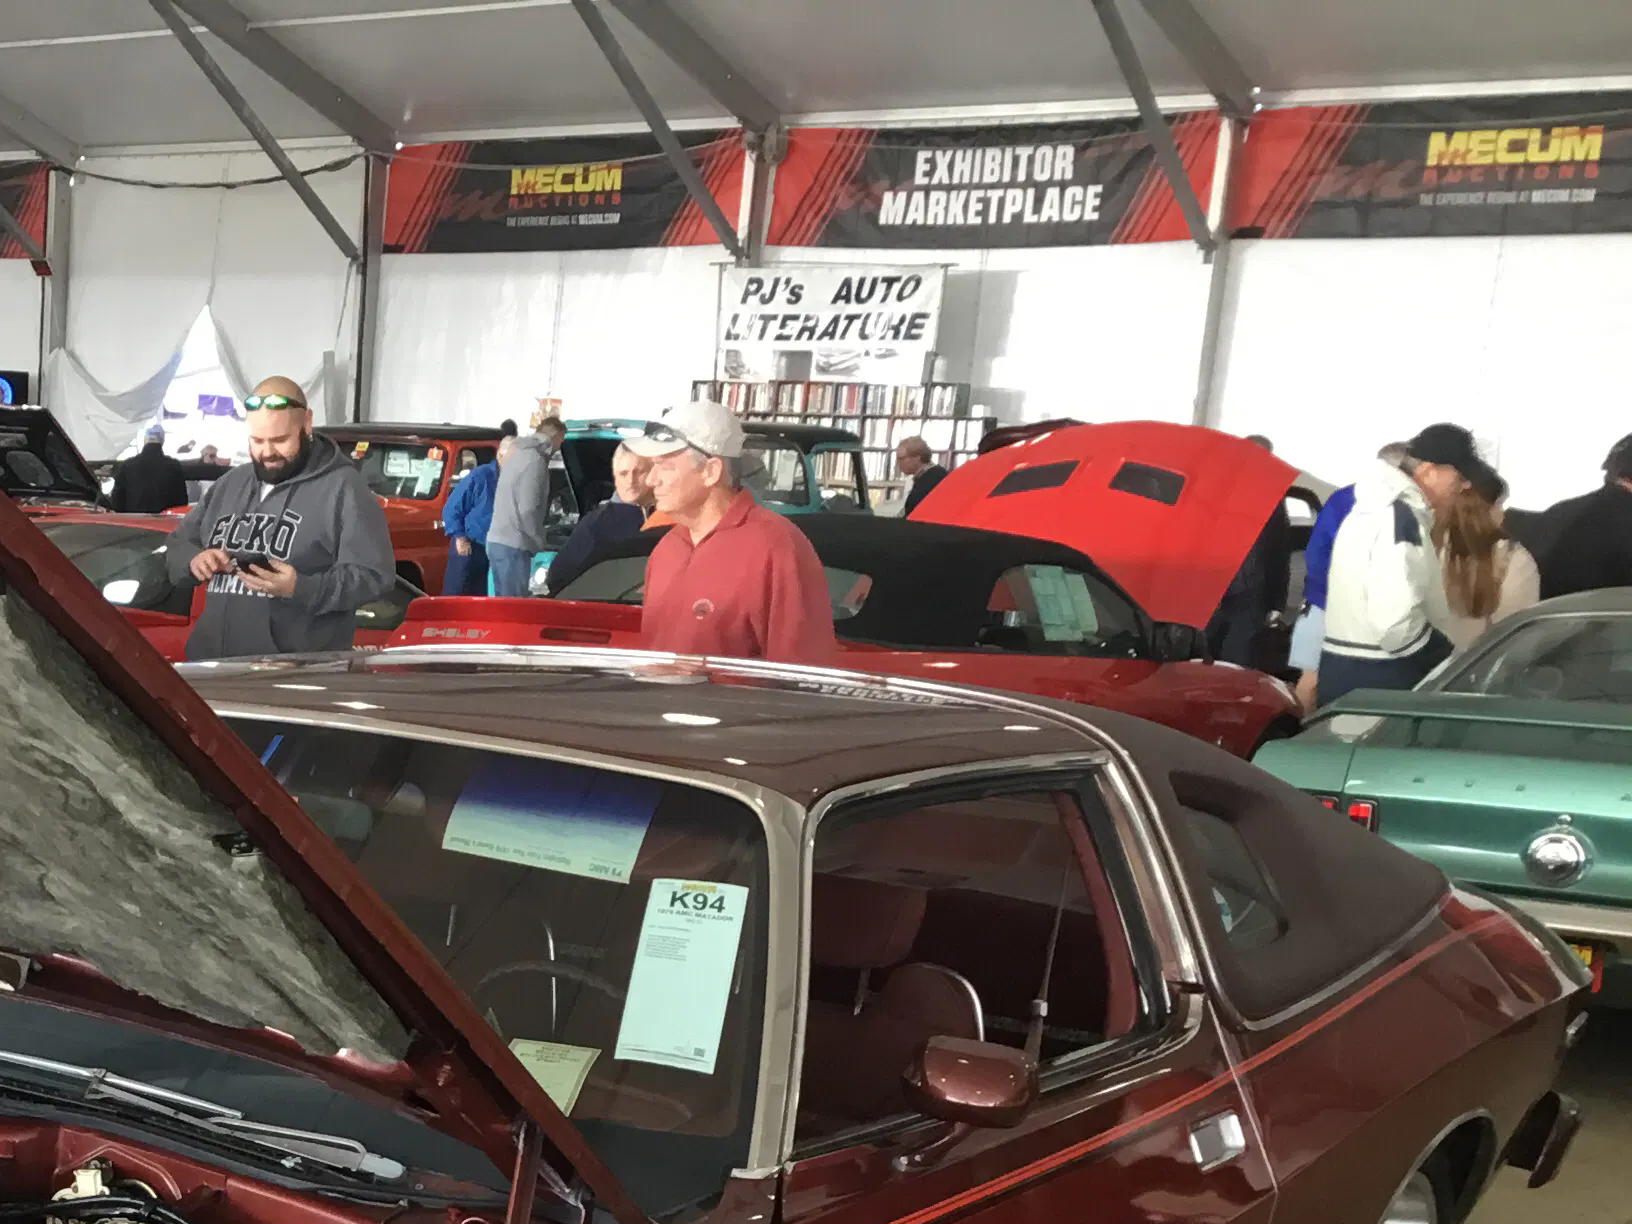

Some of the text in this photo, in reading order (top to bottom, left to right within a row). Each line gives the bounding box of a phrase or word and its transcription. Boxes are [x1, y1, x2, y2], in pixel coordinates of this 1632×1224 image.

[1426, 125, 1605, 167] MECUM
[509, 161, 623, 195] MECUM
[914, 144, 1075, 186] EXHIBITOR
[878, 184, 1104, 227] MARKETPLACE
[740, 274, 923, 306] PJ's AUTO
[724, 311, 931, 342] LITERATURE
[421, 627, 491, 639] SHELBY
[669, 890, 726, 913] K94
